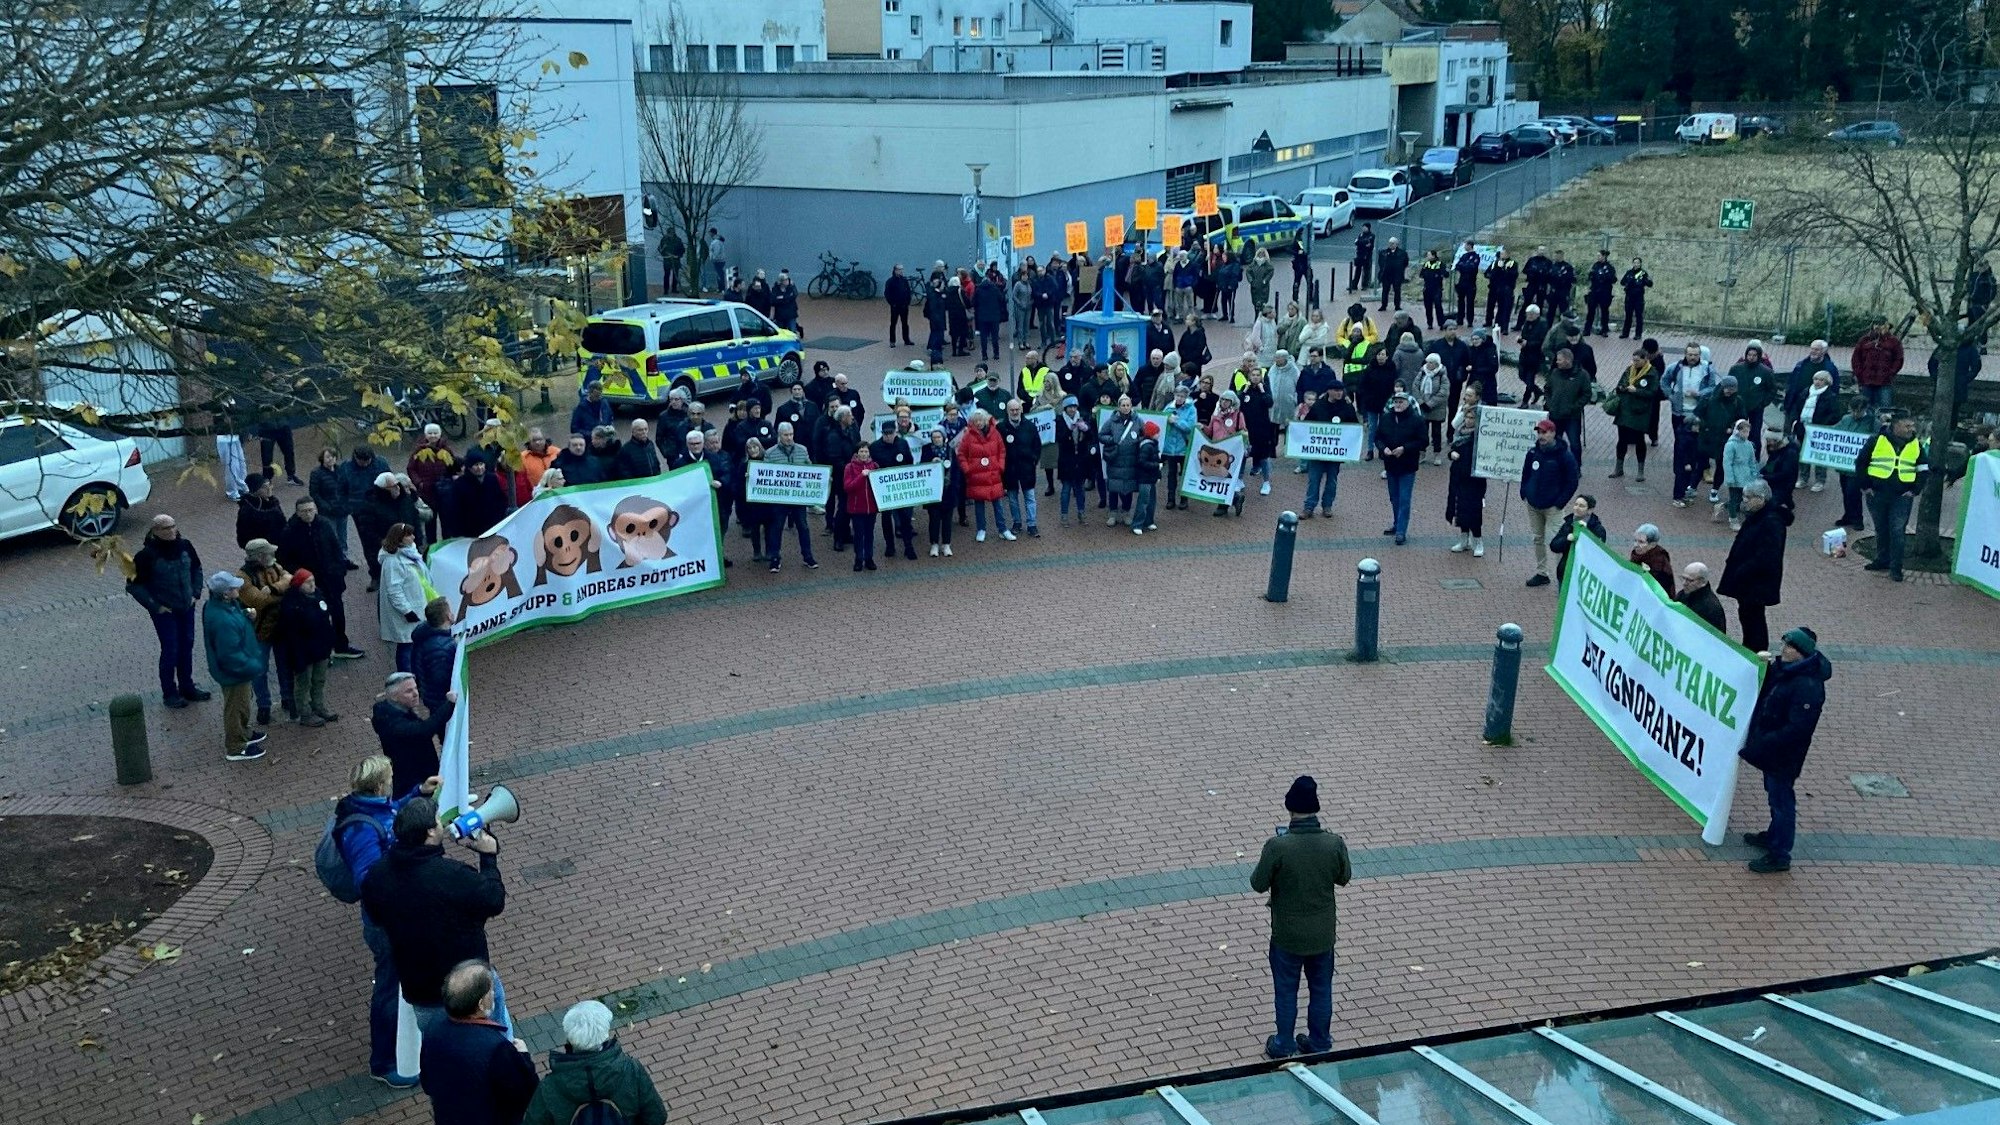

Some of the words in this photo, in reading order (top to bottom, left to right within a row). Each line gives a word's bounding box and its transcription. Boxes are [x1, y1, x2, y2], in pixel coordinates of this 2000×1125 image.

[890, 378, 945, 387] KÖNIGSDORF
[888, 387, 910, 396] WILL
[912, 388, 947, 397] DIALOG!
[1484, 412, 1523, 426] Schluss
[1309, 426, 1342, 436] DIALOG
[1310, 436, 1341, 446] STATT
[1301, 445, 1348, 456] MONOLOG!
[1810, 441, 1831, 451] MUSS
[1833, 444, 1858, 456] ENDLI
[1809, 451, 1826, 461] FREI
[1828, 454, 1856, 466] WERD
[757, 469, 774, 477] WIR
[775, 470, 795, 479] SIND
[797, 472, 822, 480] KEINE
[878, 471, 914, 484] SCHLUSS
[916, 469, 932, 478] MIT
[805, 481, 821, 489] WIR
[886, 480, 926, 493] TAUBHEIT
[752, 487, 790, 497] FORDERN
[792, 489, 823, 498] DIALOG!
[882, 494, 892, 503] IM
[893, 488, 933, 501] RATHAUS!
[509, 593, 557, 620] STUPP
[562, 592, 572, 606] &
[576, 575, 636, 604] ANDREAS
[640, 559, 706, 586] PÖTTGEN
[1578, 563, 1630, 633] KEINE
[1625, 608, 1738, 730] AKZEPTANZ
[1581, 632, 1606, 685] BEI
[1605, 658, 1705, 777] IGNORANZ!
